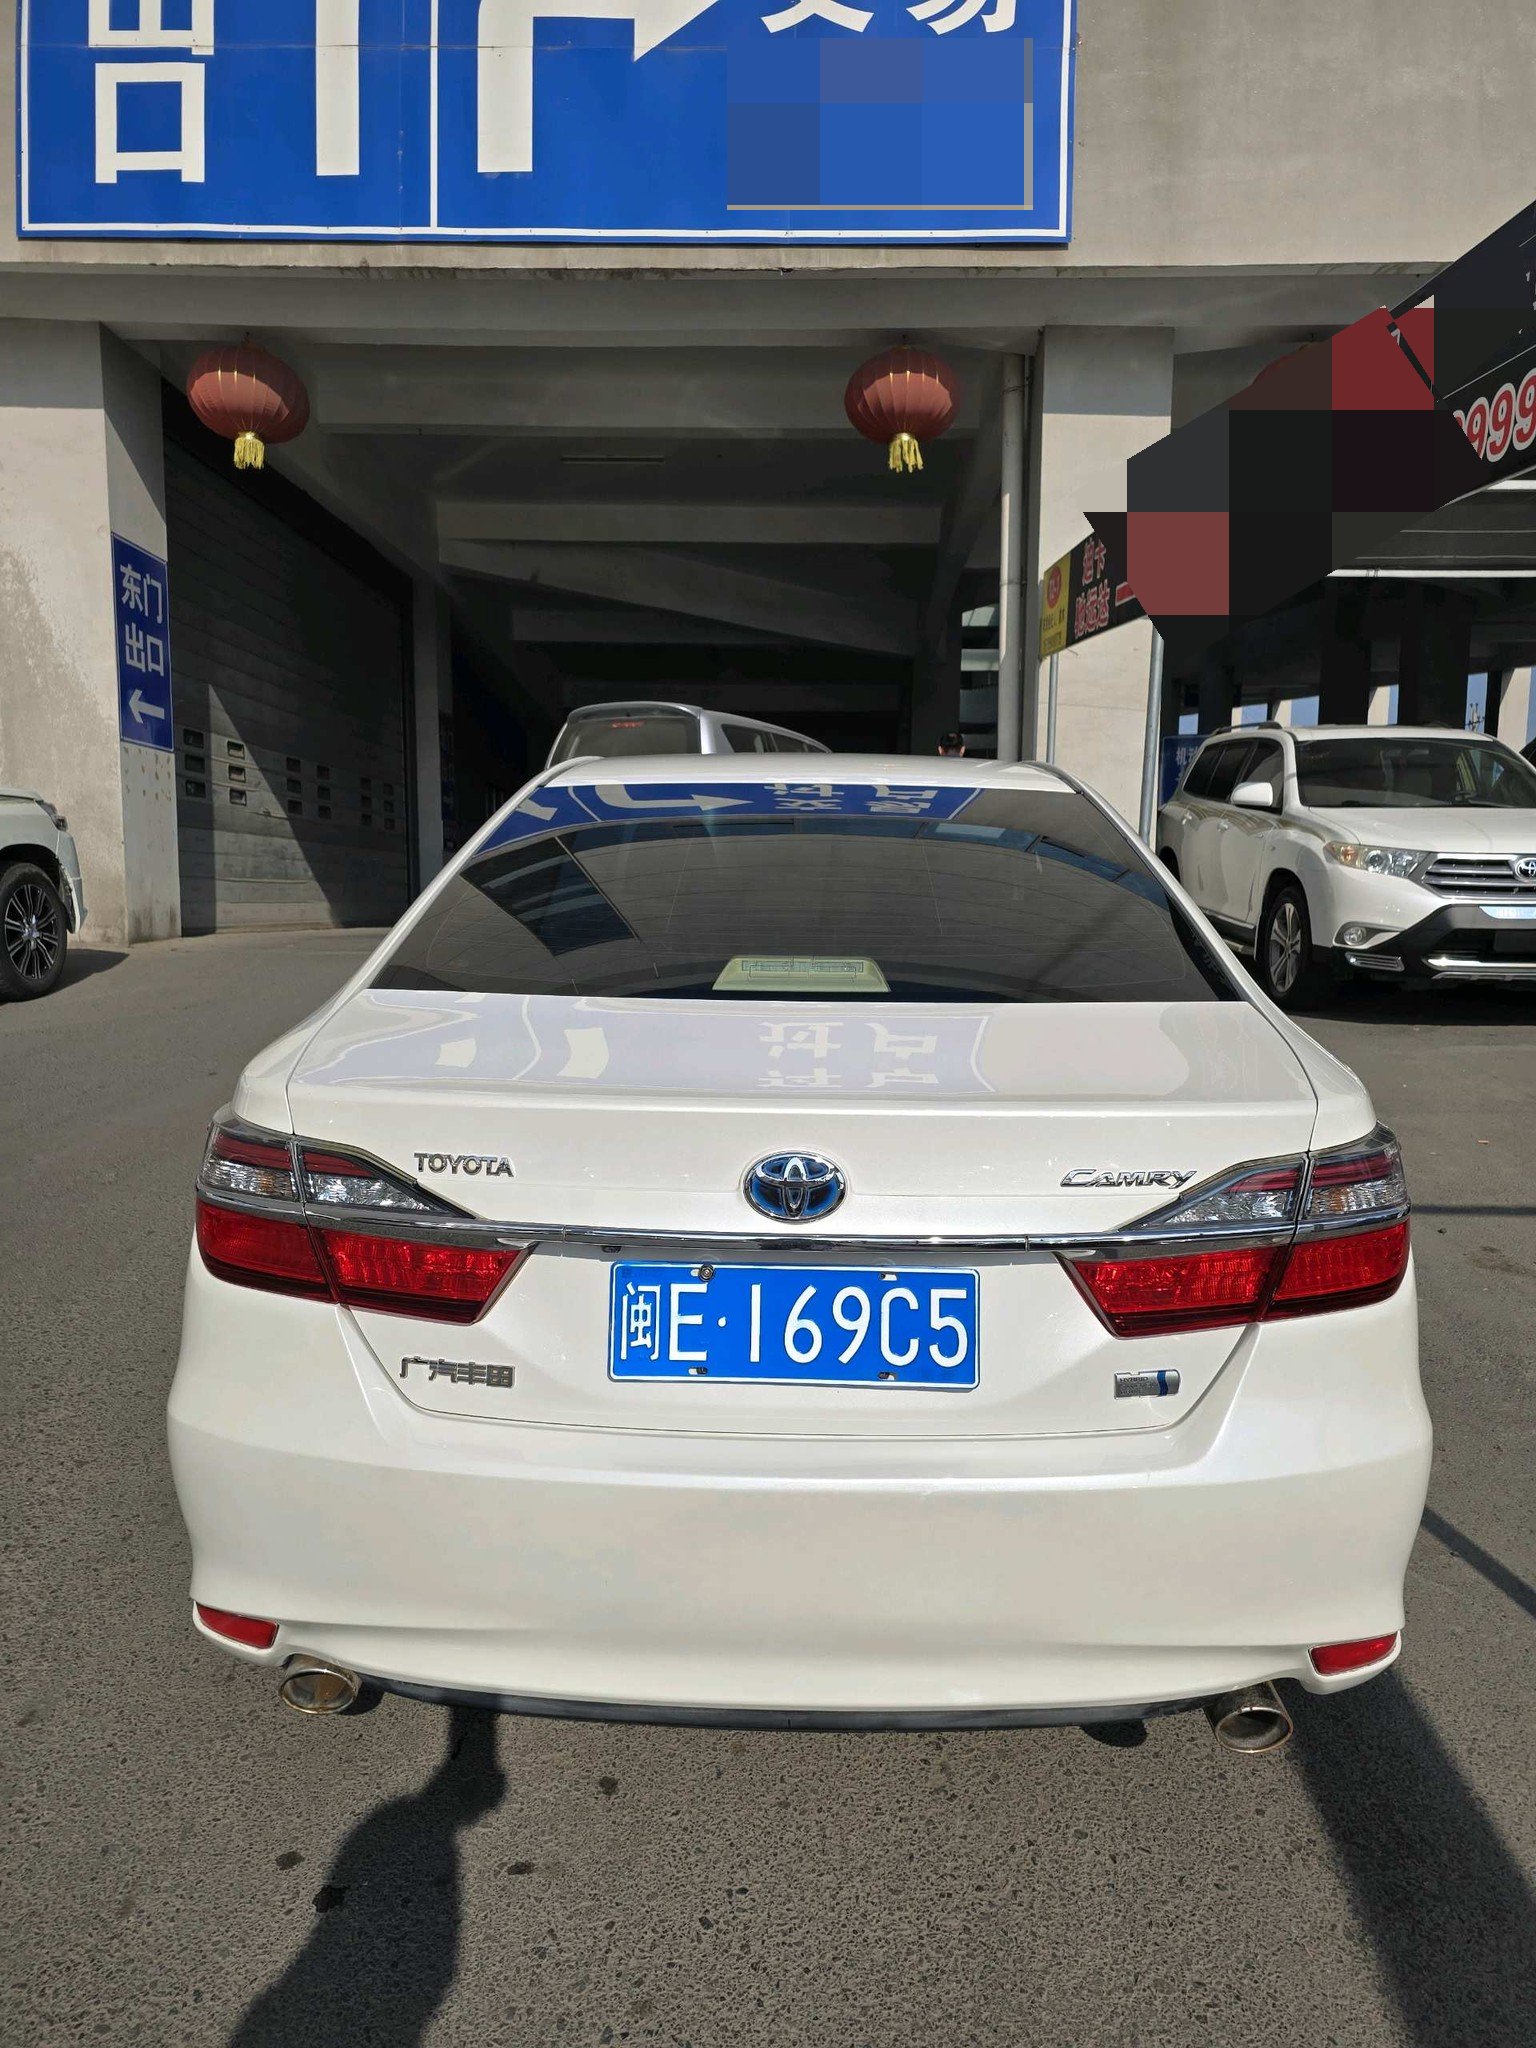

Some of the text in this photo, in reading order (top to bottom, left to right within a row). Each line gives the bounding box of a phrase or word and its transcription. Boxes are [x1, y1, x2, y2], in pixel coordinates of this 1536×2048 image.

[119, 563, 163, 624] 东门
[124, 622, 165, 677] 出口
[413, 1152, 515, 1178] TOYOTA
[1060, 1168, 1198, 1190] CAMRY
[399, 1356, 516, 1388] 广汽丰田
